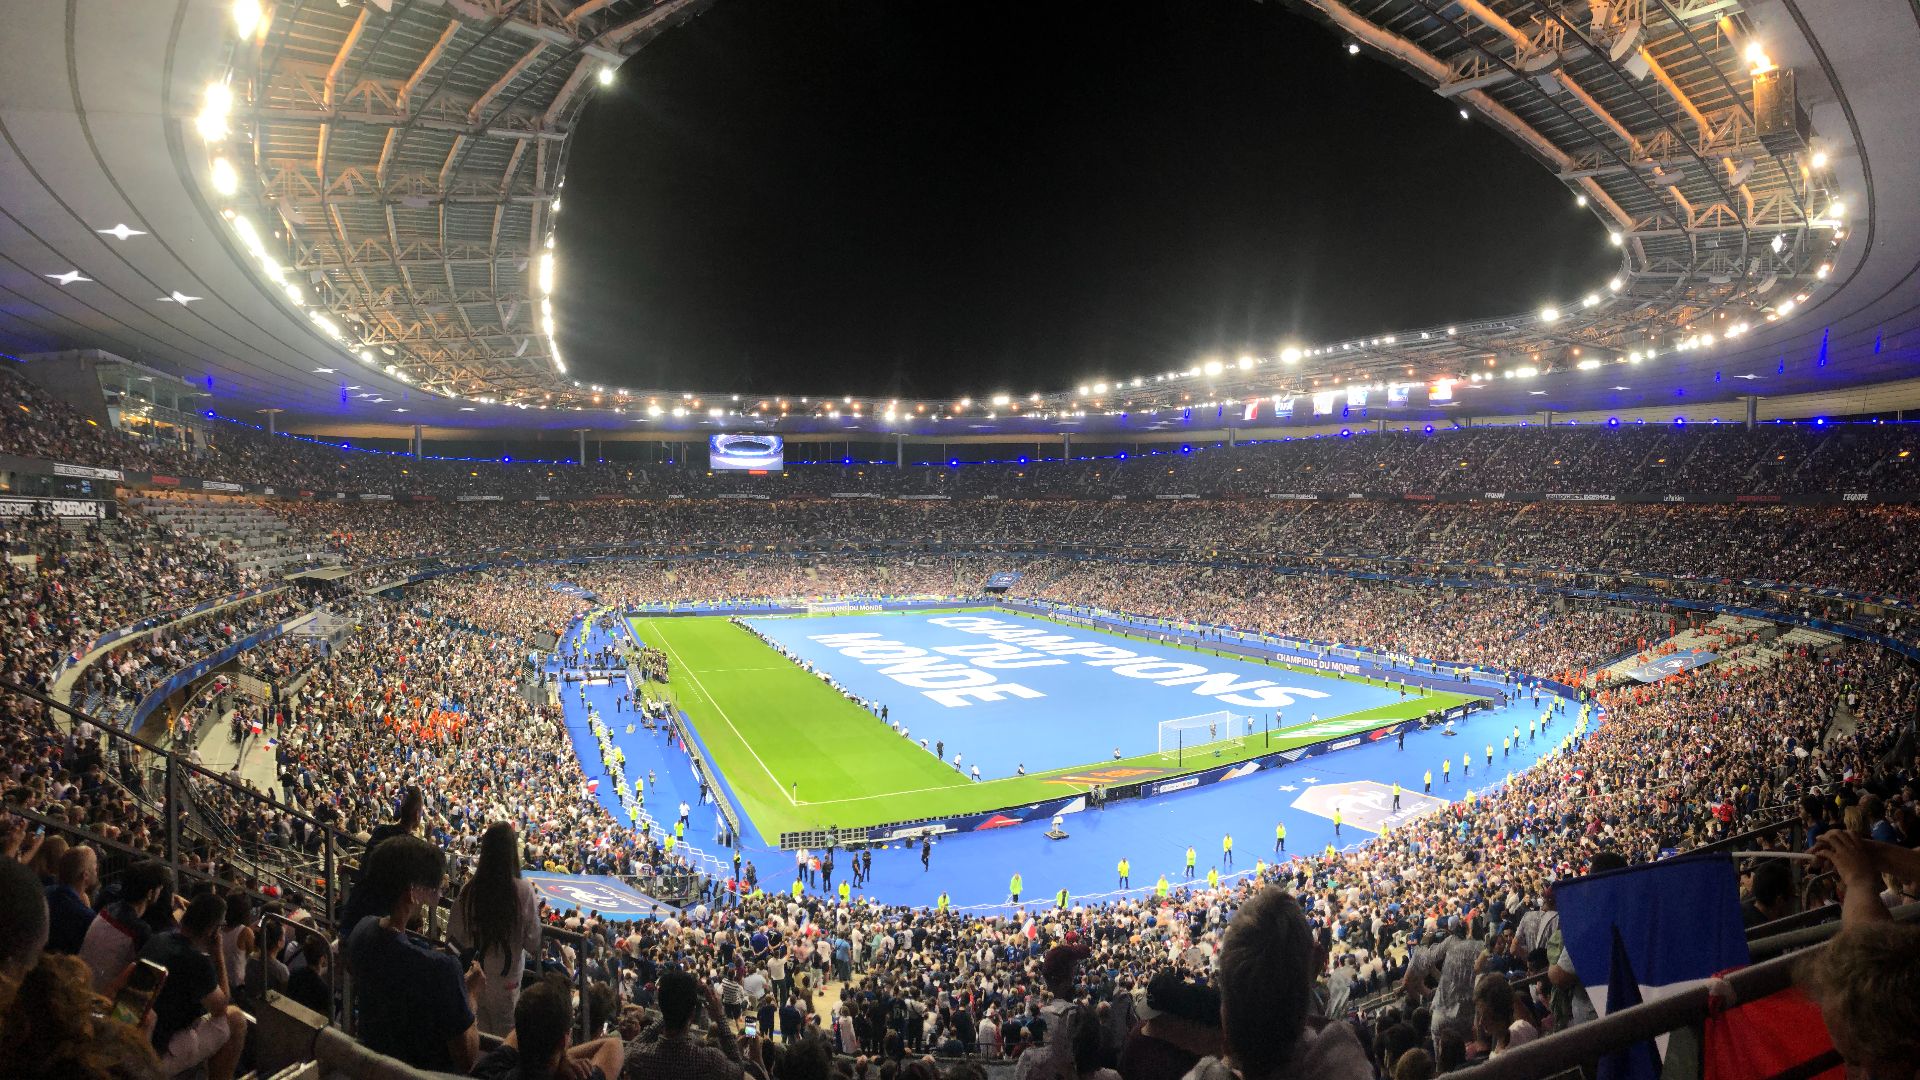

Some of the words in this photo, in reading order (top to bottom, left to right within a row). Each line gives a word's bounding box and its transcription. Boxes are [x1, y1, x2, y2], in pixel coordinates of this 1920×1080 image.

[807, 632, 1048, 708] MONDE
[927, 617, 1332, 707] CHAMPIONS
[930, 642, 1071, 668] DU
[1276, 653, 1319, 668] CHAMPIONS
[1319, 659, 1330, 670] DU
[1331, 662, 1360, 674] MONDE
